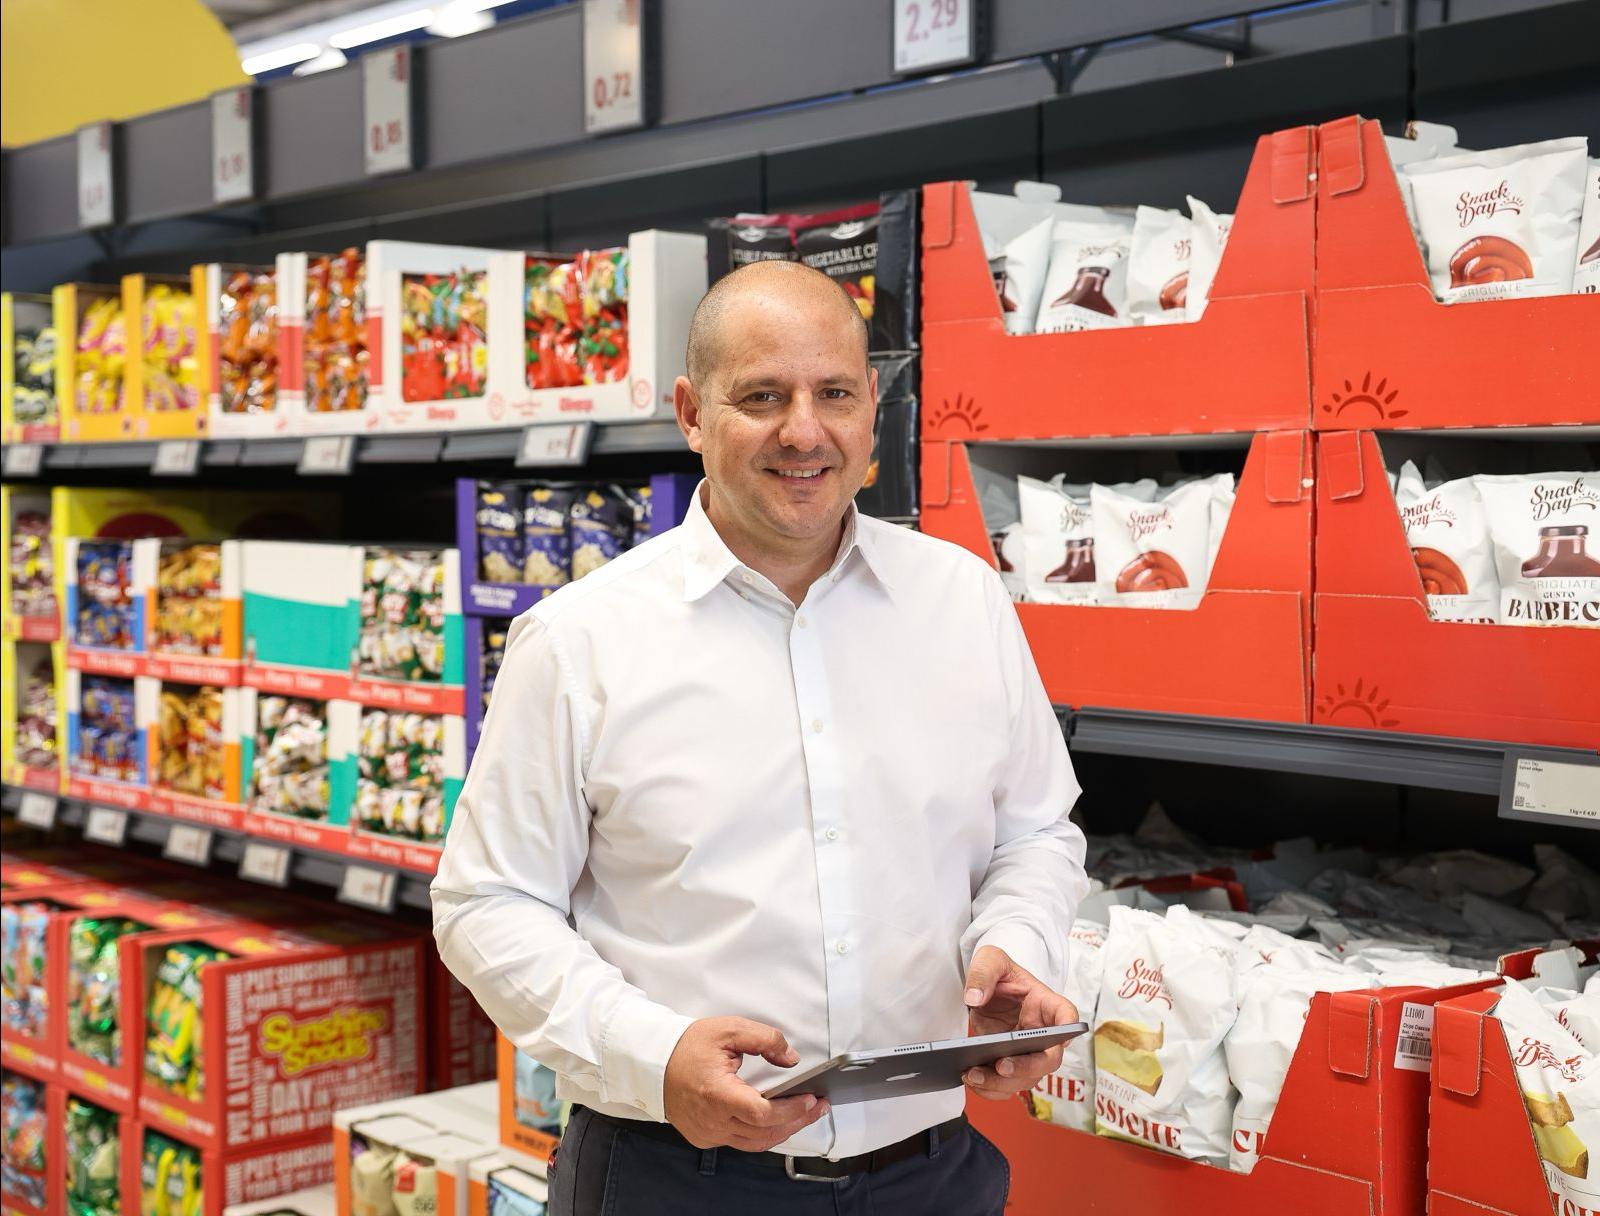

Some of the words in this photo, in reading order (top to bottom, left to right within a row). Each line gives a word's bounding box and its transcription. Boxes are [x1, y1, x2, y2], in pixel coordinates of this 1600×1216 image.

[906, 0, 958, 42] 2.29
[594, 71, 630, 109] 0.72
[1456, 180, 1508, 212] Snack
[1459, 202, 1520, 228] Day
[1530, 477, 1584, 505] Snack
[1127, 505, 1168, 529] Snack
[1532, 498, 1596, 521] Day
[1543, 591, 1575, 600] GUSTO
[370, 684, 400, 701] Party
[403, 687, 432, 704] Time
[371, 842, 399, 861] Party
[404, 847, 435, 866] Time
[1118, 979, 1172, 1010] Day
[262, 1006, 385, 1053] Sunshine
[271, 1078, 313, 1115] DAY
